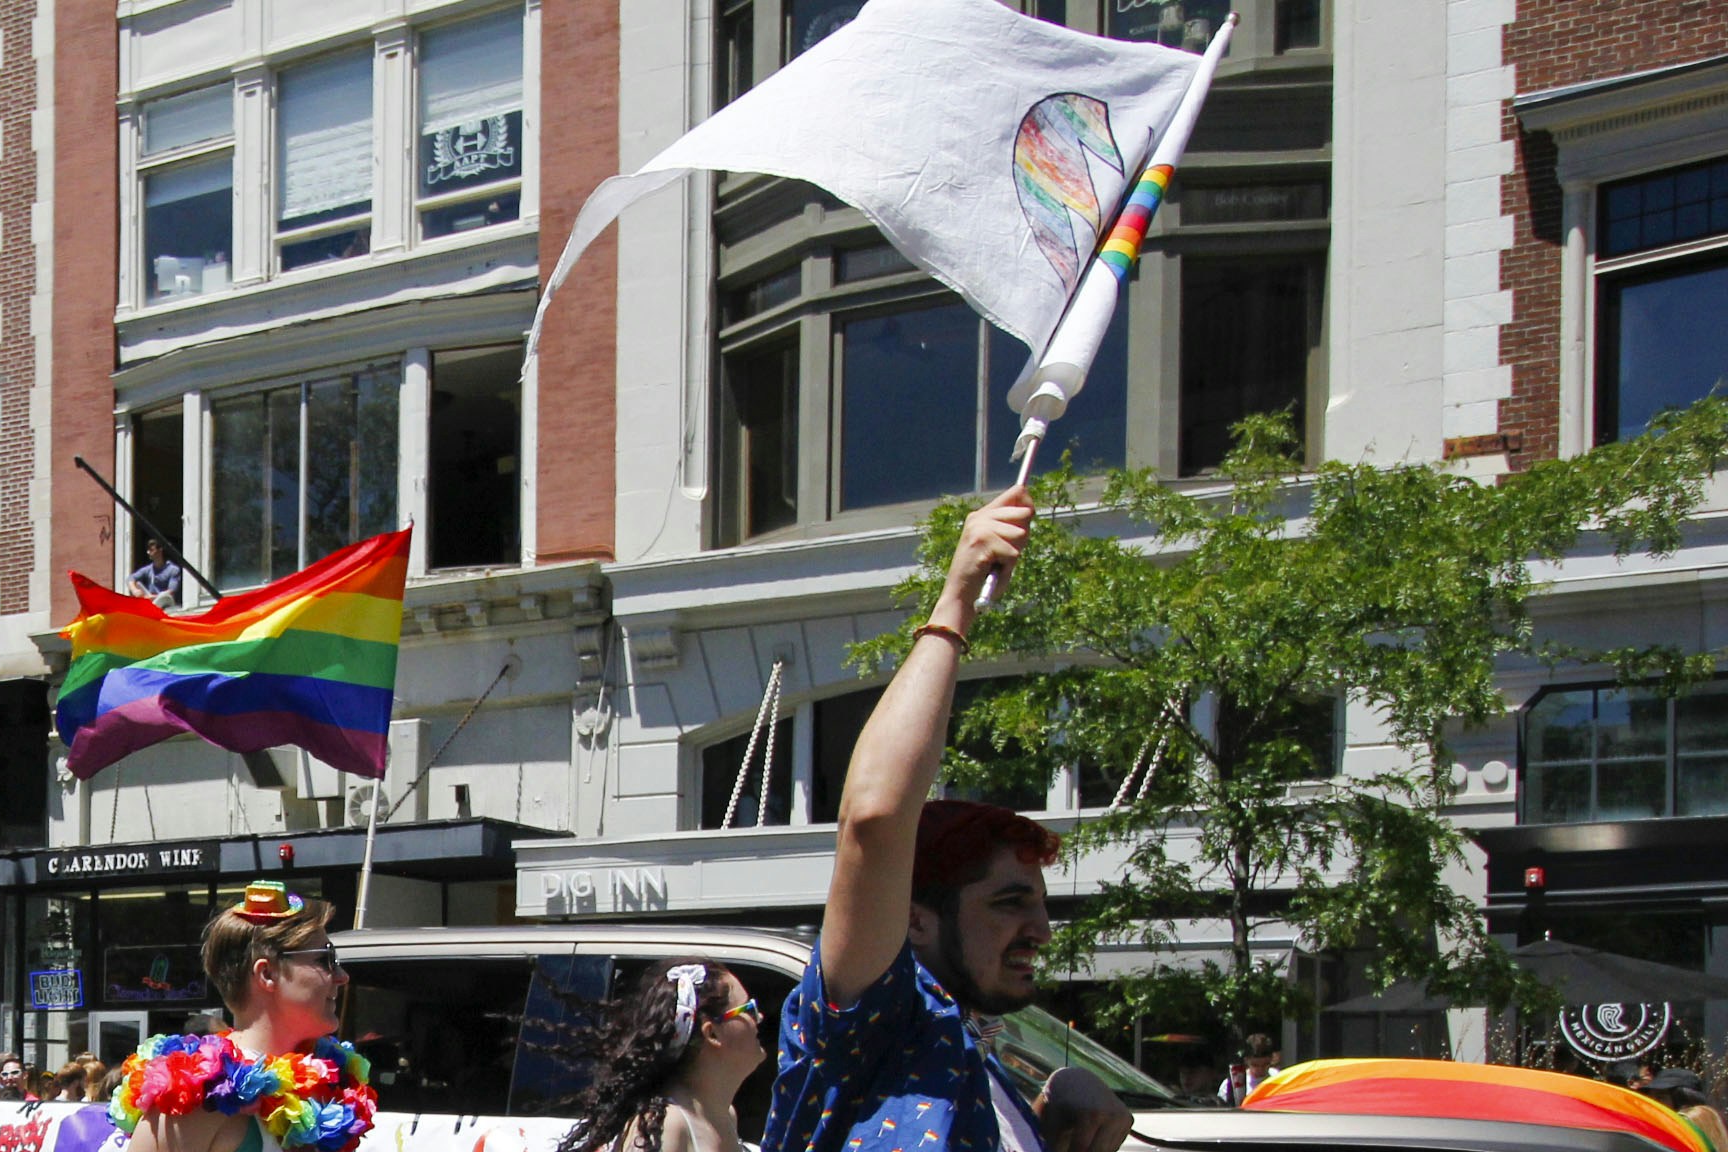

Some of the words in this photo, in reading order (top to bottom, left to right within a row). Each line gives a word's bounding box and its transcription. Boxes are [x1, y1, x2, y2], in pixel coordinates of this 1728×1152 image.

[541, 871, 593, 898] DIG
[608, 866, 665, 900] INN
[39, 974, 73, 990] BUD
[35, 989, 79, 1004] LIGHT
[1571, 1021, 1623, 1053] MEXICAN
